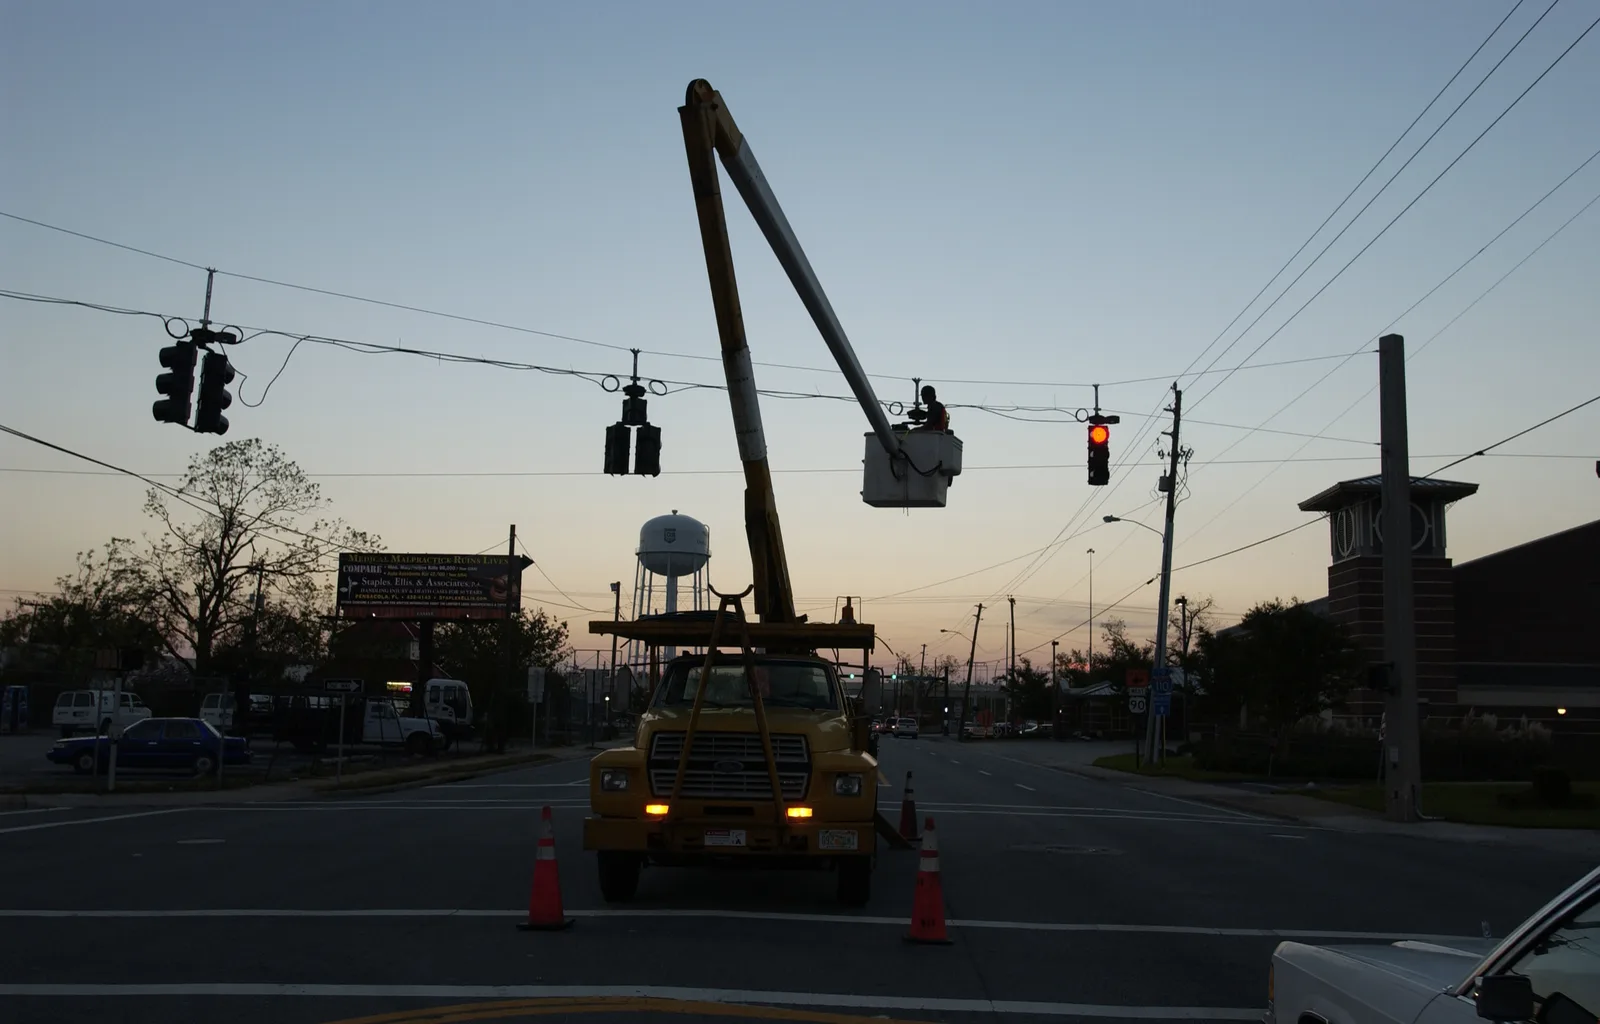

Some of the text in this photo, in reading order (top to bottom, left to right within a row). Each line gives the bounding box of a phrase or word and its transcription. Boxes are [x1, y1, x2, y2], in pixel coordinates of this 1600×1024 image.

[453, 556, 481, 564] RUINS
[483, 556, 509, 565] LIVES
[342, 565, 383, 573] COMPARE
[1155, 680, 1169, 692] 110
[1130, 700, 1144, 710] 90
